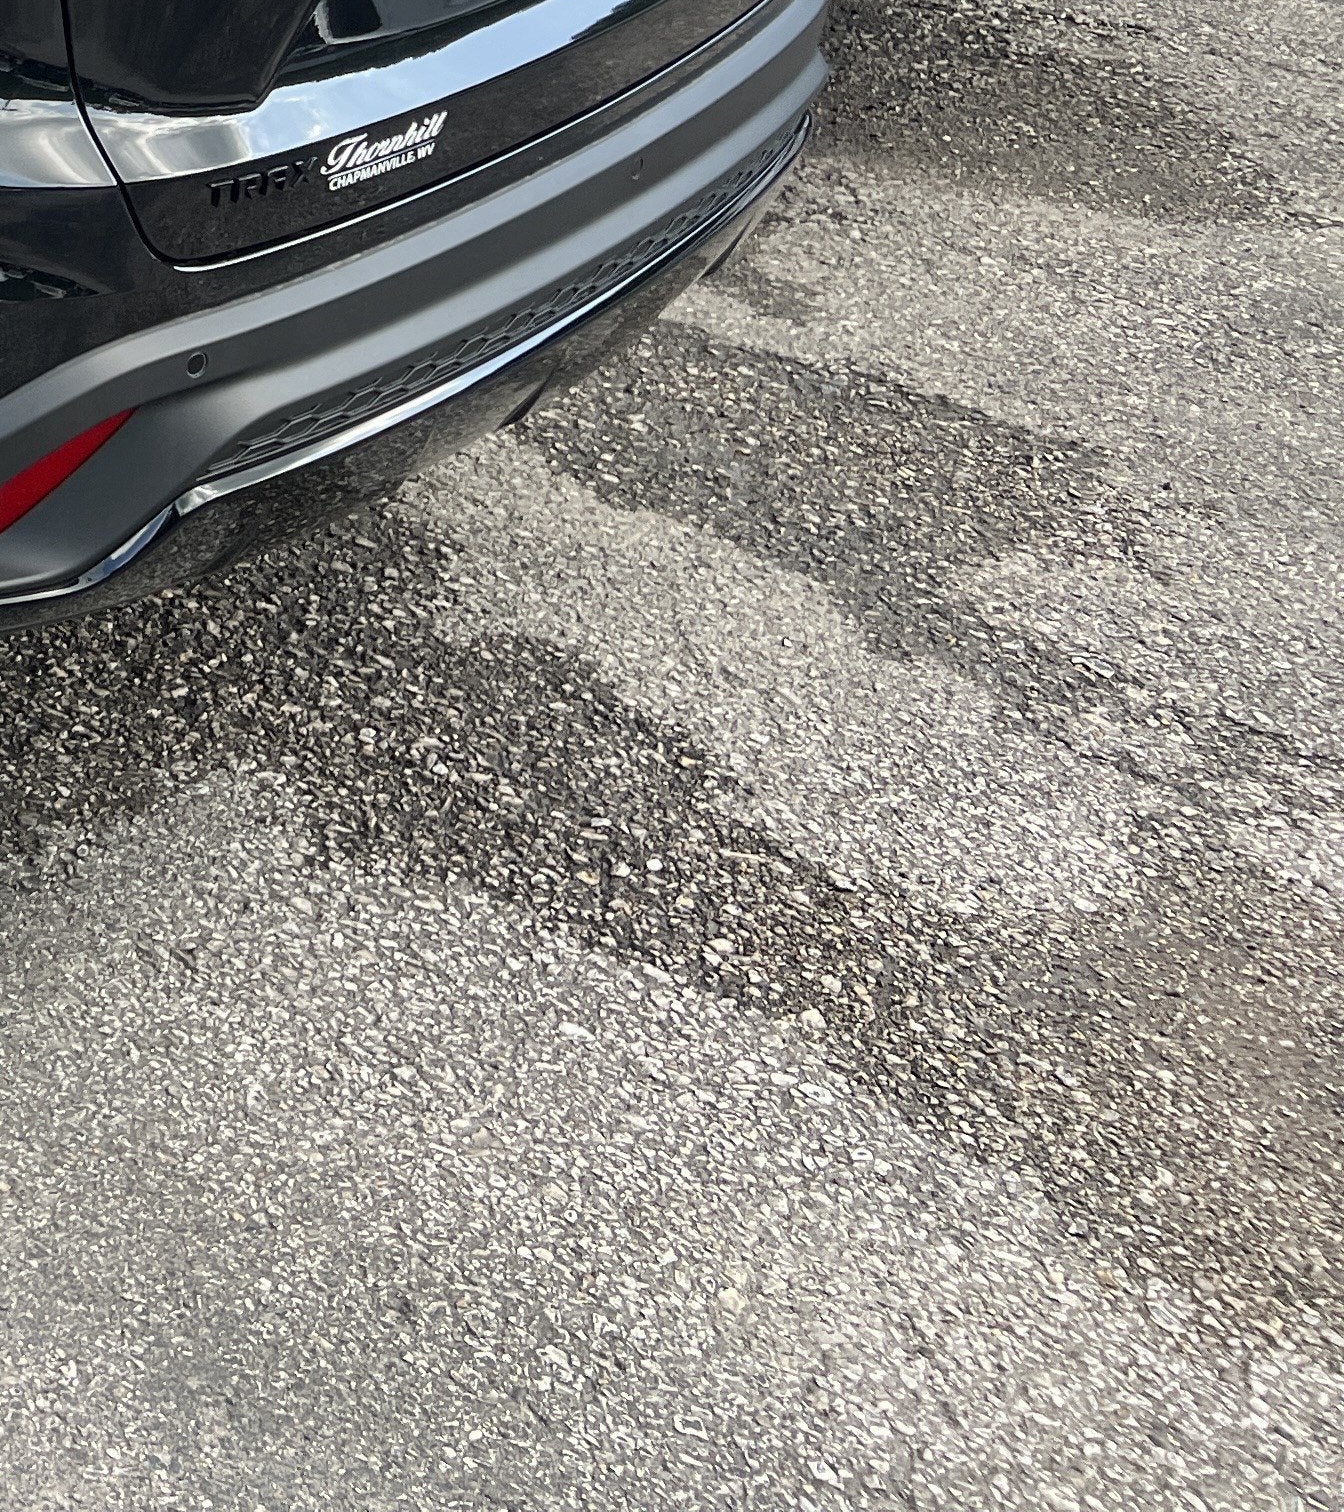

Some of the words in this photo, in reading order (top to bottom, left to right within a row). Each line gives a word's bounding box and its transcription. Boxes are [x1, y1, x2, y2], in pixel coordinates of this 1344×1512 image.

[206, 156, 318, 207] TRAX
[319, 110, 449, 176] Thornhill
[416, 142, 436, 160] WV
